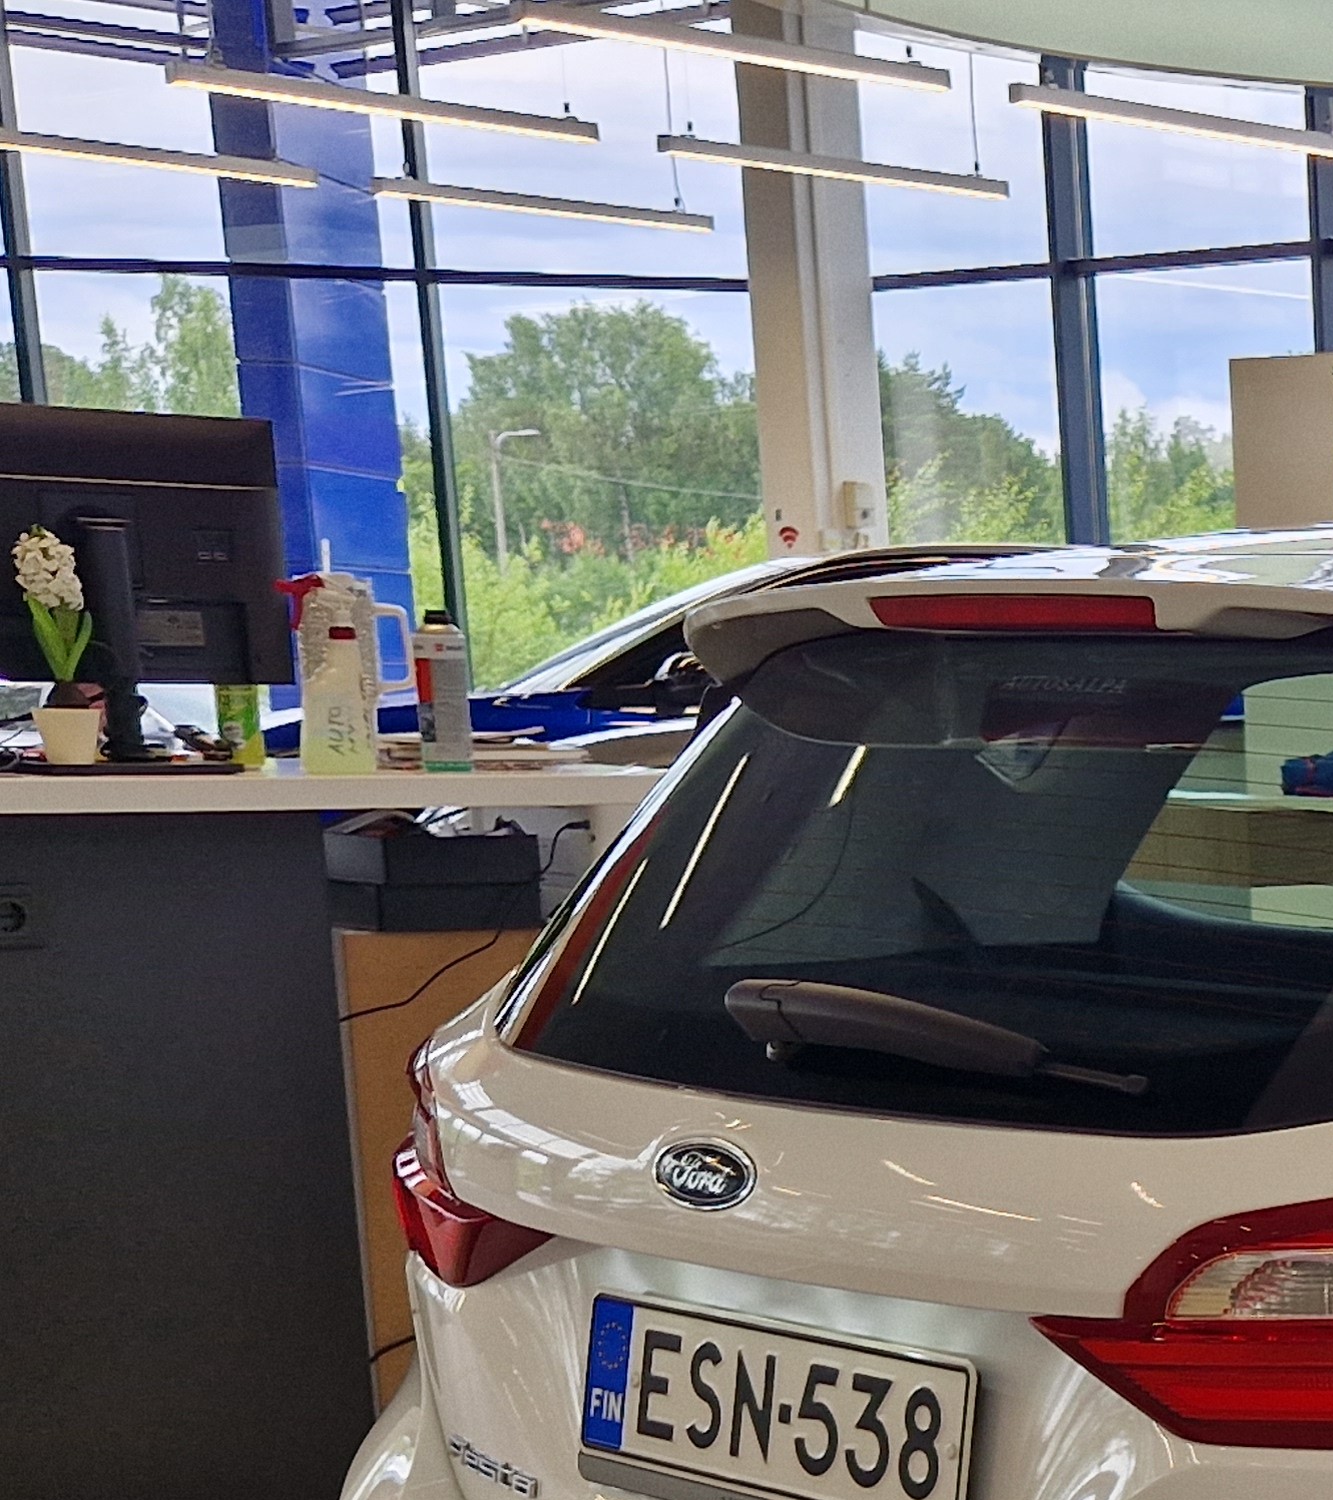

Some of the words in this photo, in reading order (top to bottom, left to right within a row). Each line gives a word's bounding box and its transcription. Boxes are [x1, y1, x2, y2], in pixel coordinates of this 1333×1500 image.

[662, 1151, 737, 1196] Ford
[589, 1387, 623, 1424] FIN
[637, 1329, 941, 1500] ESN-538
